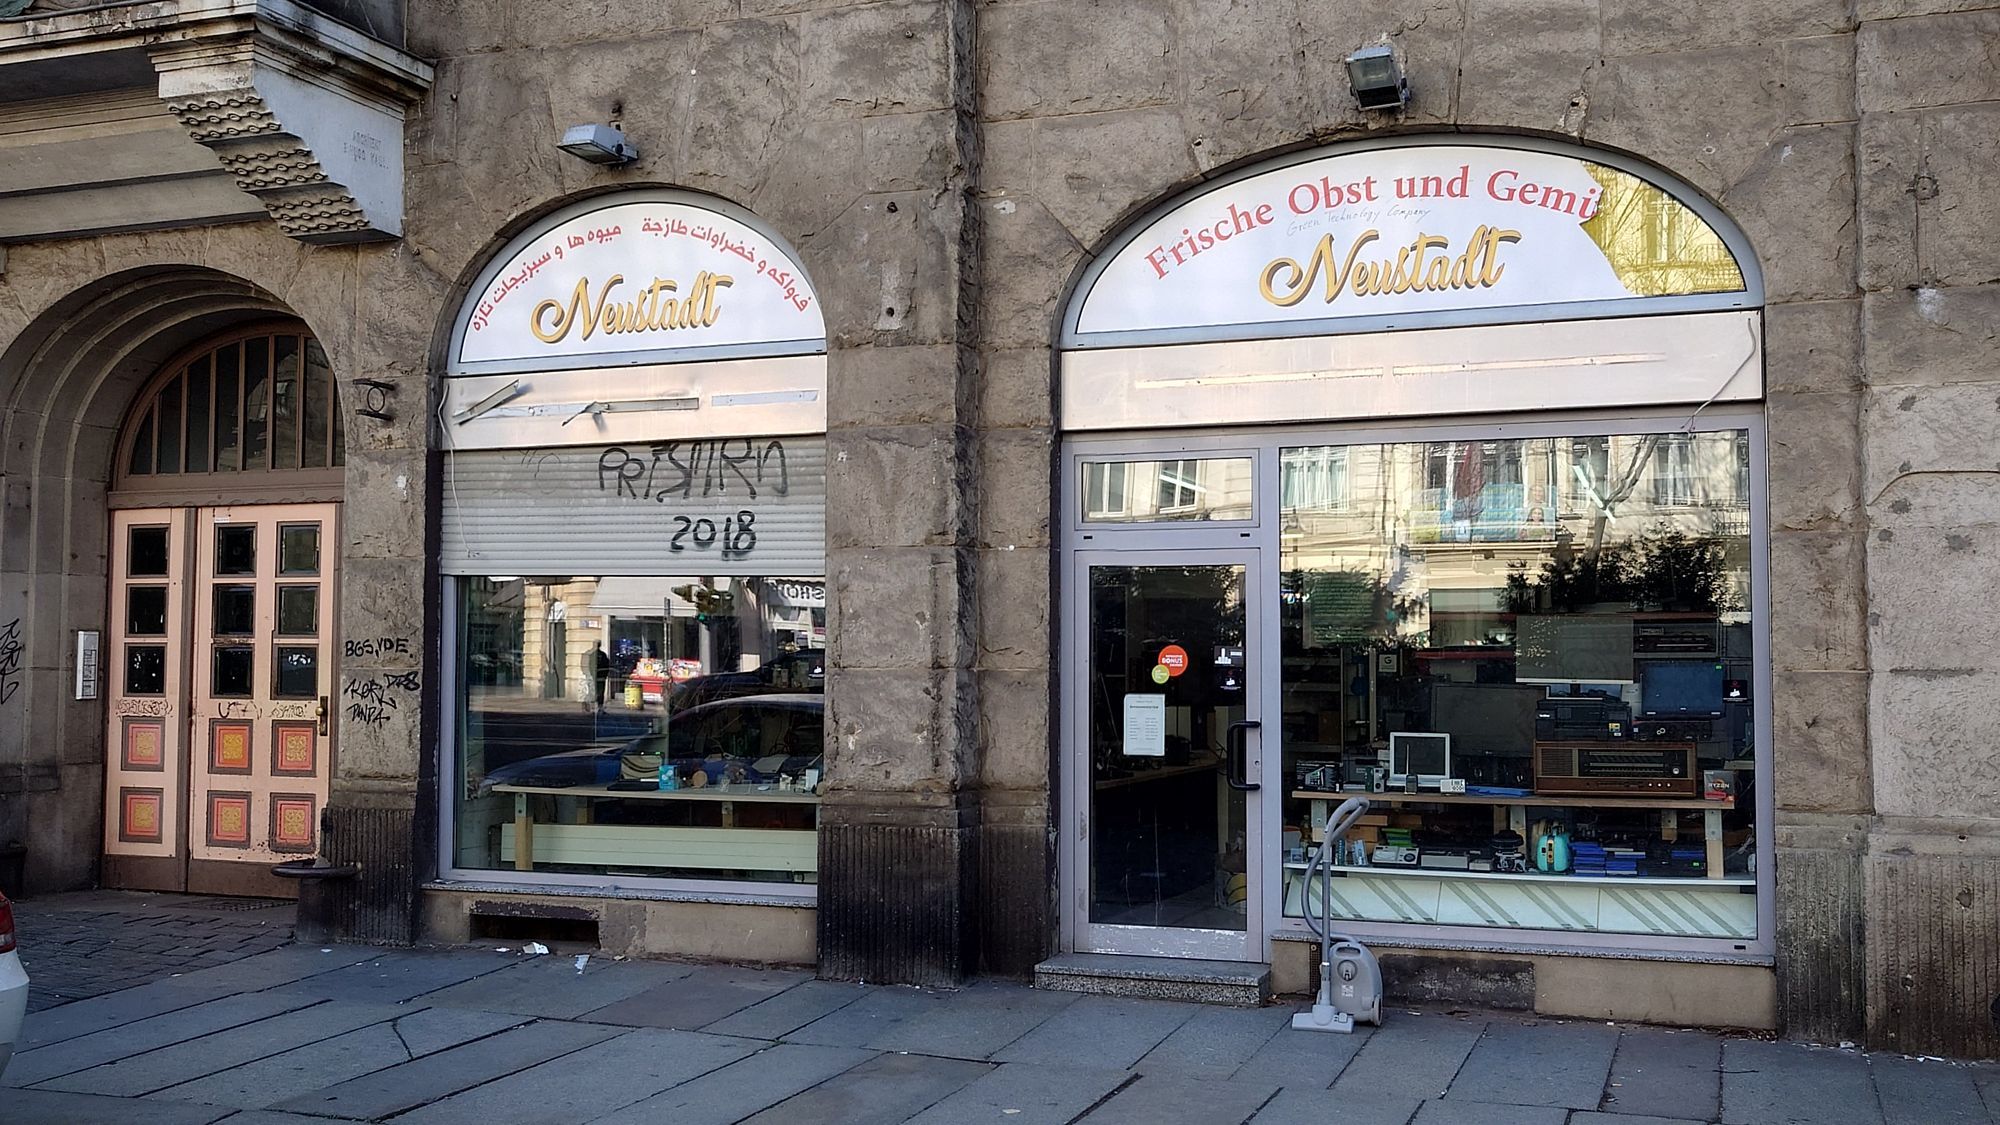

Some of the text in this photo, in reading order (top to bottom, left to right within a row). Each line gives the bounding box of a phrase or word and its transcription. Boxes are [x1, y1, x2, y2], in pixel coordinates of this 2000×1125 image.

[1144, 202, 1274, 279] Frische
[1288, 175, 1378, 215] Obst
[1394, 164, 1469, 199] und
[1286, 204, 1431, 236] Green Technology Company
[554, 245, 564, 259] و
[757, 259, 767, 274] و
[1258, 224, 1523, 308] Neustadt
[530, 270, 734, 344] Neustadt
[670, 510, 757, 556] 2018
